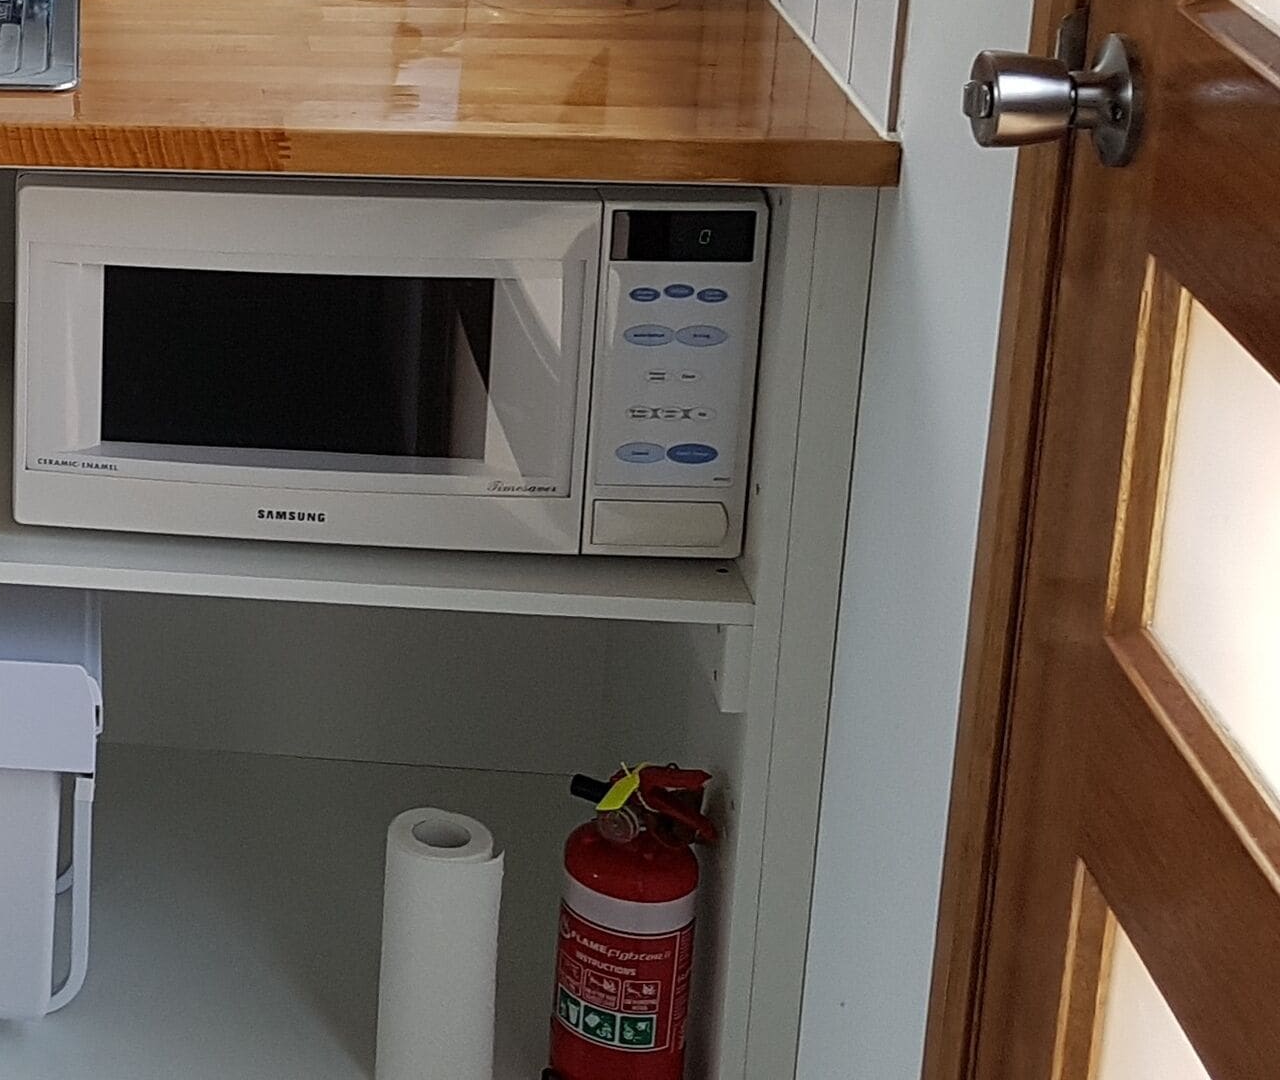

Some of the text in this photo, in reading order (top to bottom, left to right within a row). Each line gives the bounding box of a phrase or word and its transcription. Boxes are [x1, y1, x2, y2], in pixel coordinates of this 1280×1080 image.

[37, 457, 119, 472] CERAMIC ENAMEL
[257, 509, 326, 523] SAMSUNG
[575, 950, 638, 976] INSTRUCTIONS
